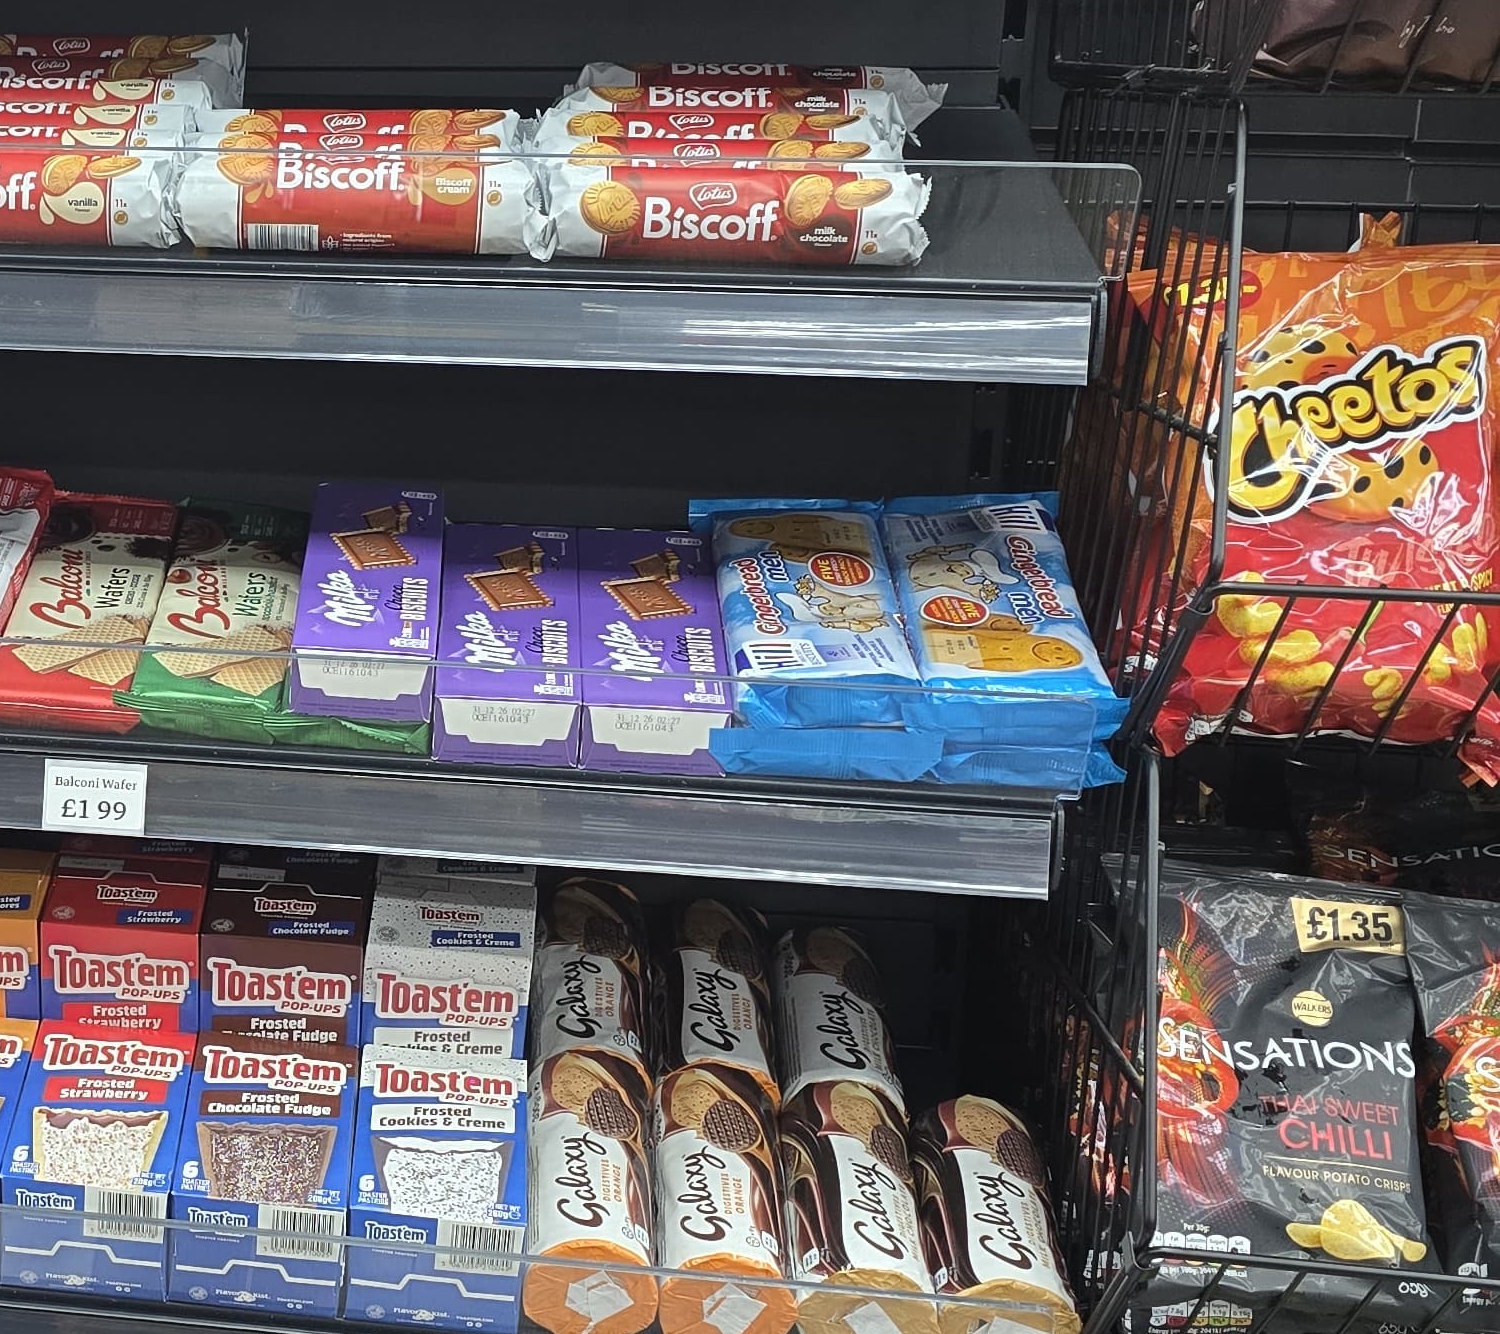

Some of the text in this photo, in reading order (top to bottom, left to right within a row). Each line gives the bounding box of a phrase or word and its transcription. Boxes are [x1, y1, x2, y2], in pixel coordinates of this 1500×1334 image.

[649, 86, 773, 109] Biscoff
[643, 199, 778, 242] Biscoff
[1224, 342, 1482, 516] Cheetos
[97, 567, 130, 608] Wafers
[732, 557, 786, 637] Gingerbread
[55, 776, 137, 790] Balconi Wafer
[1306, 906, 1393, 945] £1.35
[1293, 1002, 1332, 1016] WALKERS
[1157, 1017, 1416, 1078] SENSATIONS
[206, 1049, 344, 1083] Toast'em
[377, 1063, 514, 1096] Toast'em
[60, 1089, 149, 1101] Strawberry
[77, 1078, 135, 1091] Frosted
[208, 1102, 331, 1118] Chocolate Fudge
[379, 1116, 505, 1130] Cookies Creme
[1259, 1094, 1399, 1126] THAI SWEET
[1279, 1119, 1392, 1161] CHILLI
[557, 1129, 605, 1229] Galaxy
[681, 1144, 726, 1243] Galaxy
[1262, 1165, 1412, 1194] FLAVOUR POTATO CRISPS
[853, 1161, 902, 1261] Galaxy
